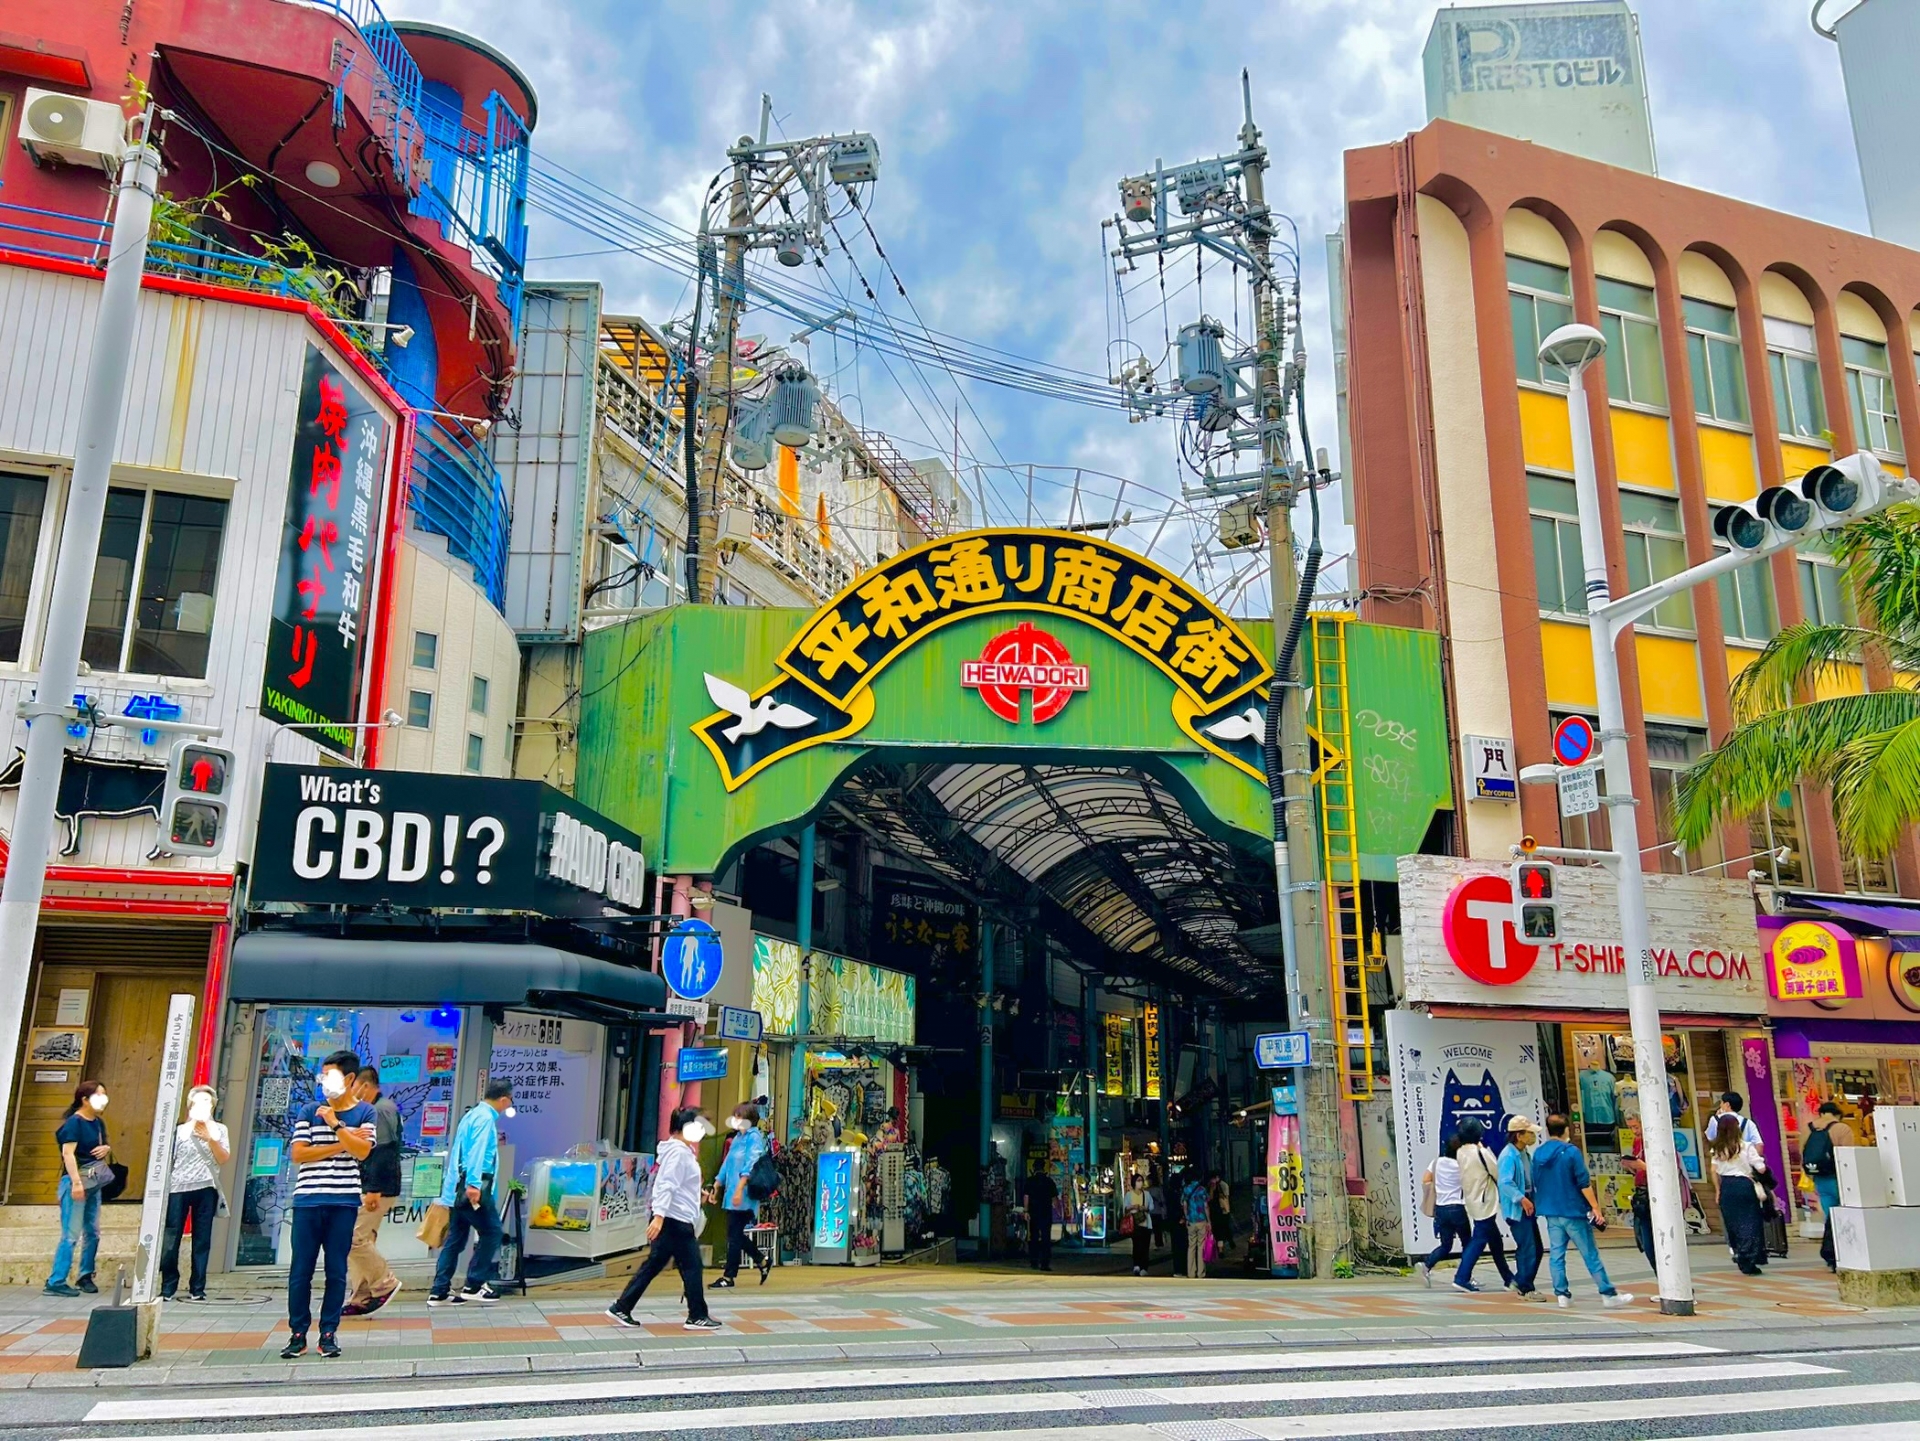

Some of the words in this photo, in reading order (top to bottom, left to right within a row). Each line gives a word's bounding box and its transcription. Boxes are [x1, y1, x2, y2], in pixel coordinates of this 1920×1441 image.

[288, 373, 350, 689] 焼肉パナリ
[338, 419, 378, 649] 沖縄黒毛和牛
[799, 537, 1250, 694] 平和通り商店街
[966, 662, 1087, 686] HEIWADORI
[266, 686, 317, 724] YAKINIKU
[318, 713, 355, 749] PANARI
[1482, 747, 1508, 773] 門
[300, 774, 382, 804] What's
[1494, 790, 1515, 798] COFFEE
[1566, 800, 1595, 813] ここから
[292, 805, 506, 886] CBD!?
[549, 812, 607, 894] #ADD
[606, 841, 645, 908] CBD
[890, 893, 965, 917] 珍味と沖縄の味
[1466, 899, 1513, 969] T
[1784, 978, 1839, 995] 御菓子御殿
[538, 1019, 563, 1044] CBD
[165, 1013, 184, 1088] ようこそ那覇市へ
[1265, 1037, 1301, 1054] 平和通り
[1443, 1046, 1493, 1060] WELCOME
[380, 1057, 401, 1069] CBD
[1519, 1055, 1528, 1063] 2F
[159, 1101, 171, 1135] Welcome
[1415, 1086, 1426, 1144] CLOTHING
[156, 1144, 164, 1163] Naha
[831, 1157, 847, 1244] アロハシャツ
[384, 1206, 430, 1224] HEM
[1277, 1215, 1307, 1227] COS
